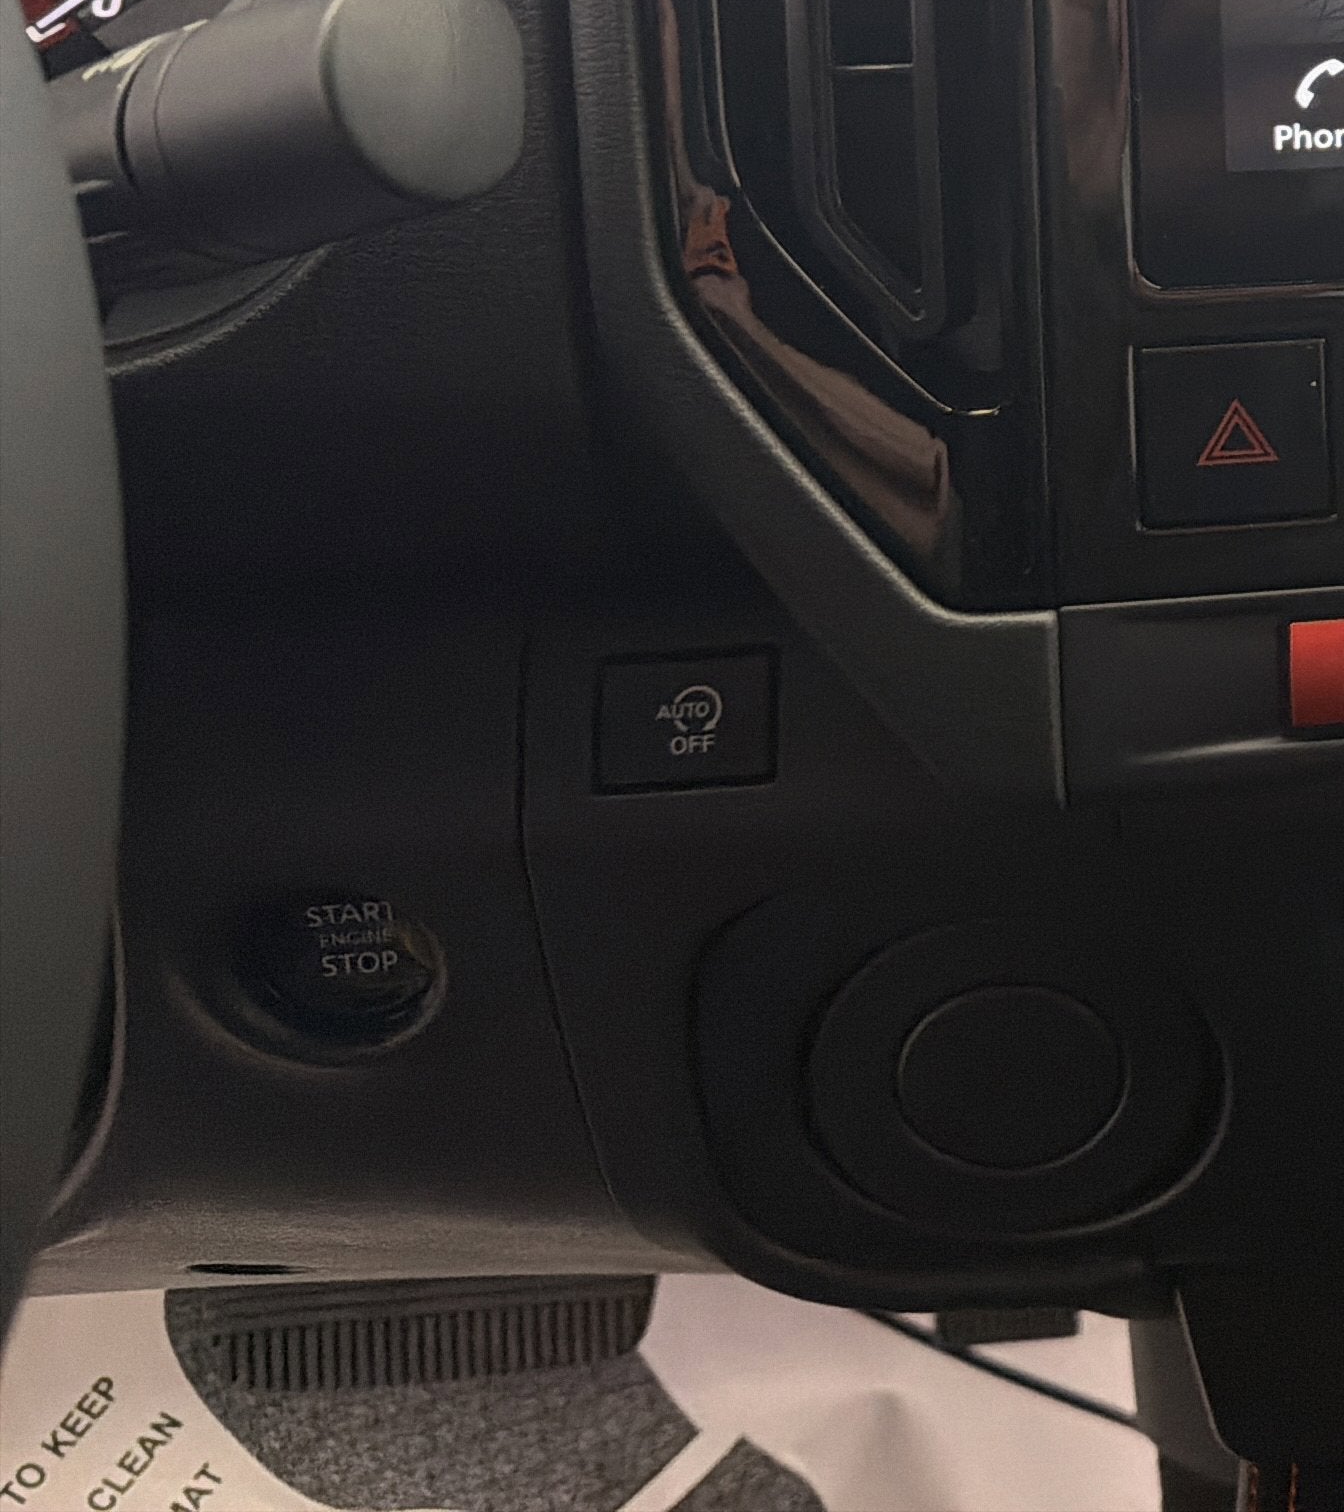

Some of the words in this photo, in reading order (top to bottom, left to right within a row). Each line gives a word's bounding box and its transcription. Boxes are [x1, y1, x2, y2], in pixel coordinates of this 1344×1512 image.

[656, 701, 710, 721] AUTO
[670, 733, 716, 756] OFF
[320, 949, 398, 978] STOP
[0, 1462, 46, 1505] TO
[41, 1376, 115, 1459] KEEP
[87, 1411, 184, 1511] CLEAN
